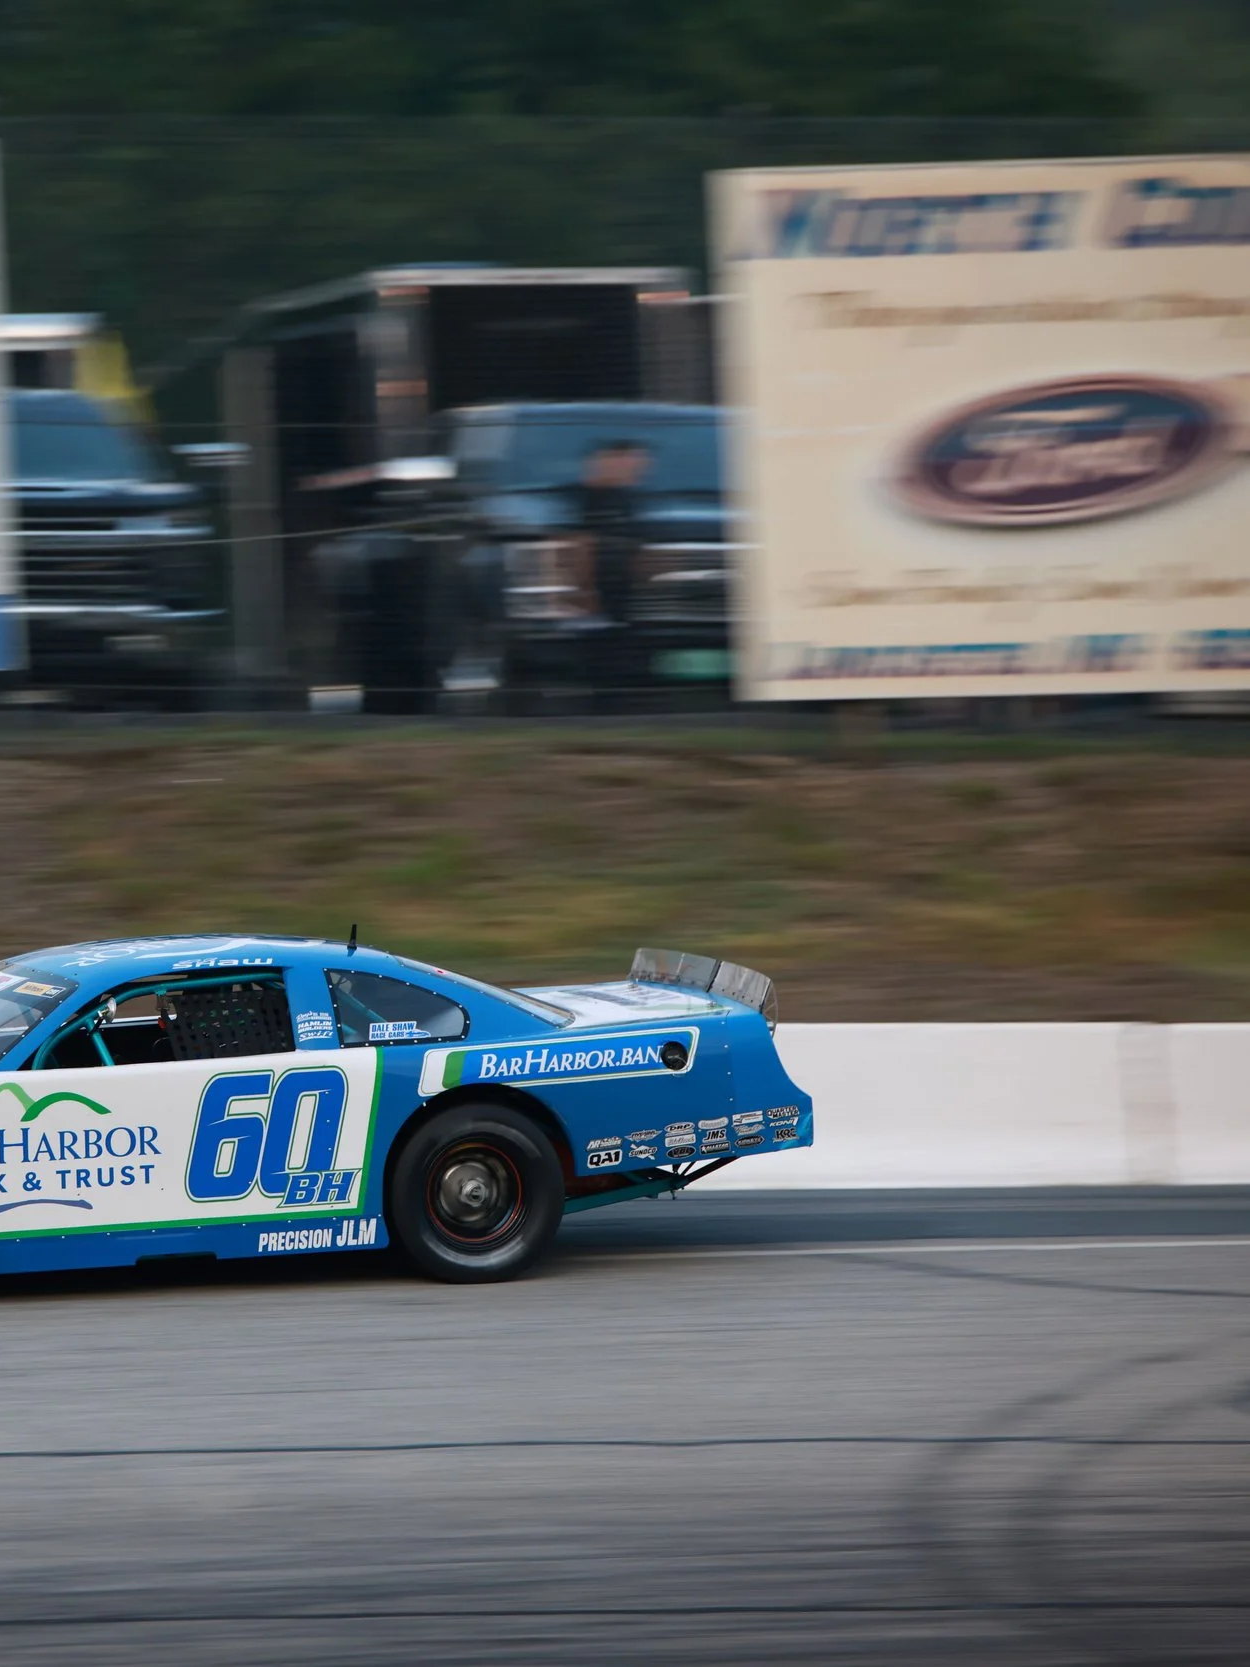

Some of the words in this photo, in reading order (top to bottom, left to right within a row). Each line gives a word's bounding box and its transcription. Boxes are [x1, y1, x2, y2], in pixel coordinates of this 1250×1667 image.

[371, 1023, 391, 1032] DALE
[392, 1022, 415, 1031] SHAW
[185, 1065, 349, 1204] 60
[703, 1129, 726, 1141] JMS
[588, 1150, 621, 1167] QA1
[630, 1147, 657, 1157] SUNOCO
[22, 1171, 42, 1192] &
[56, 1164, 155, 1189] TRUST
[278, 1168, 362, 1208] BH
[258, 1228, 333, 1252] PRECISION
[336, 1218, 377, 1247] JLM
